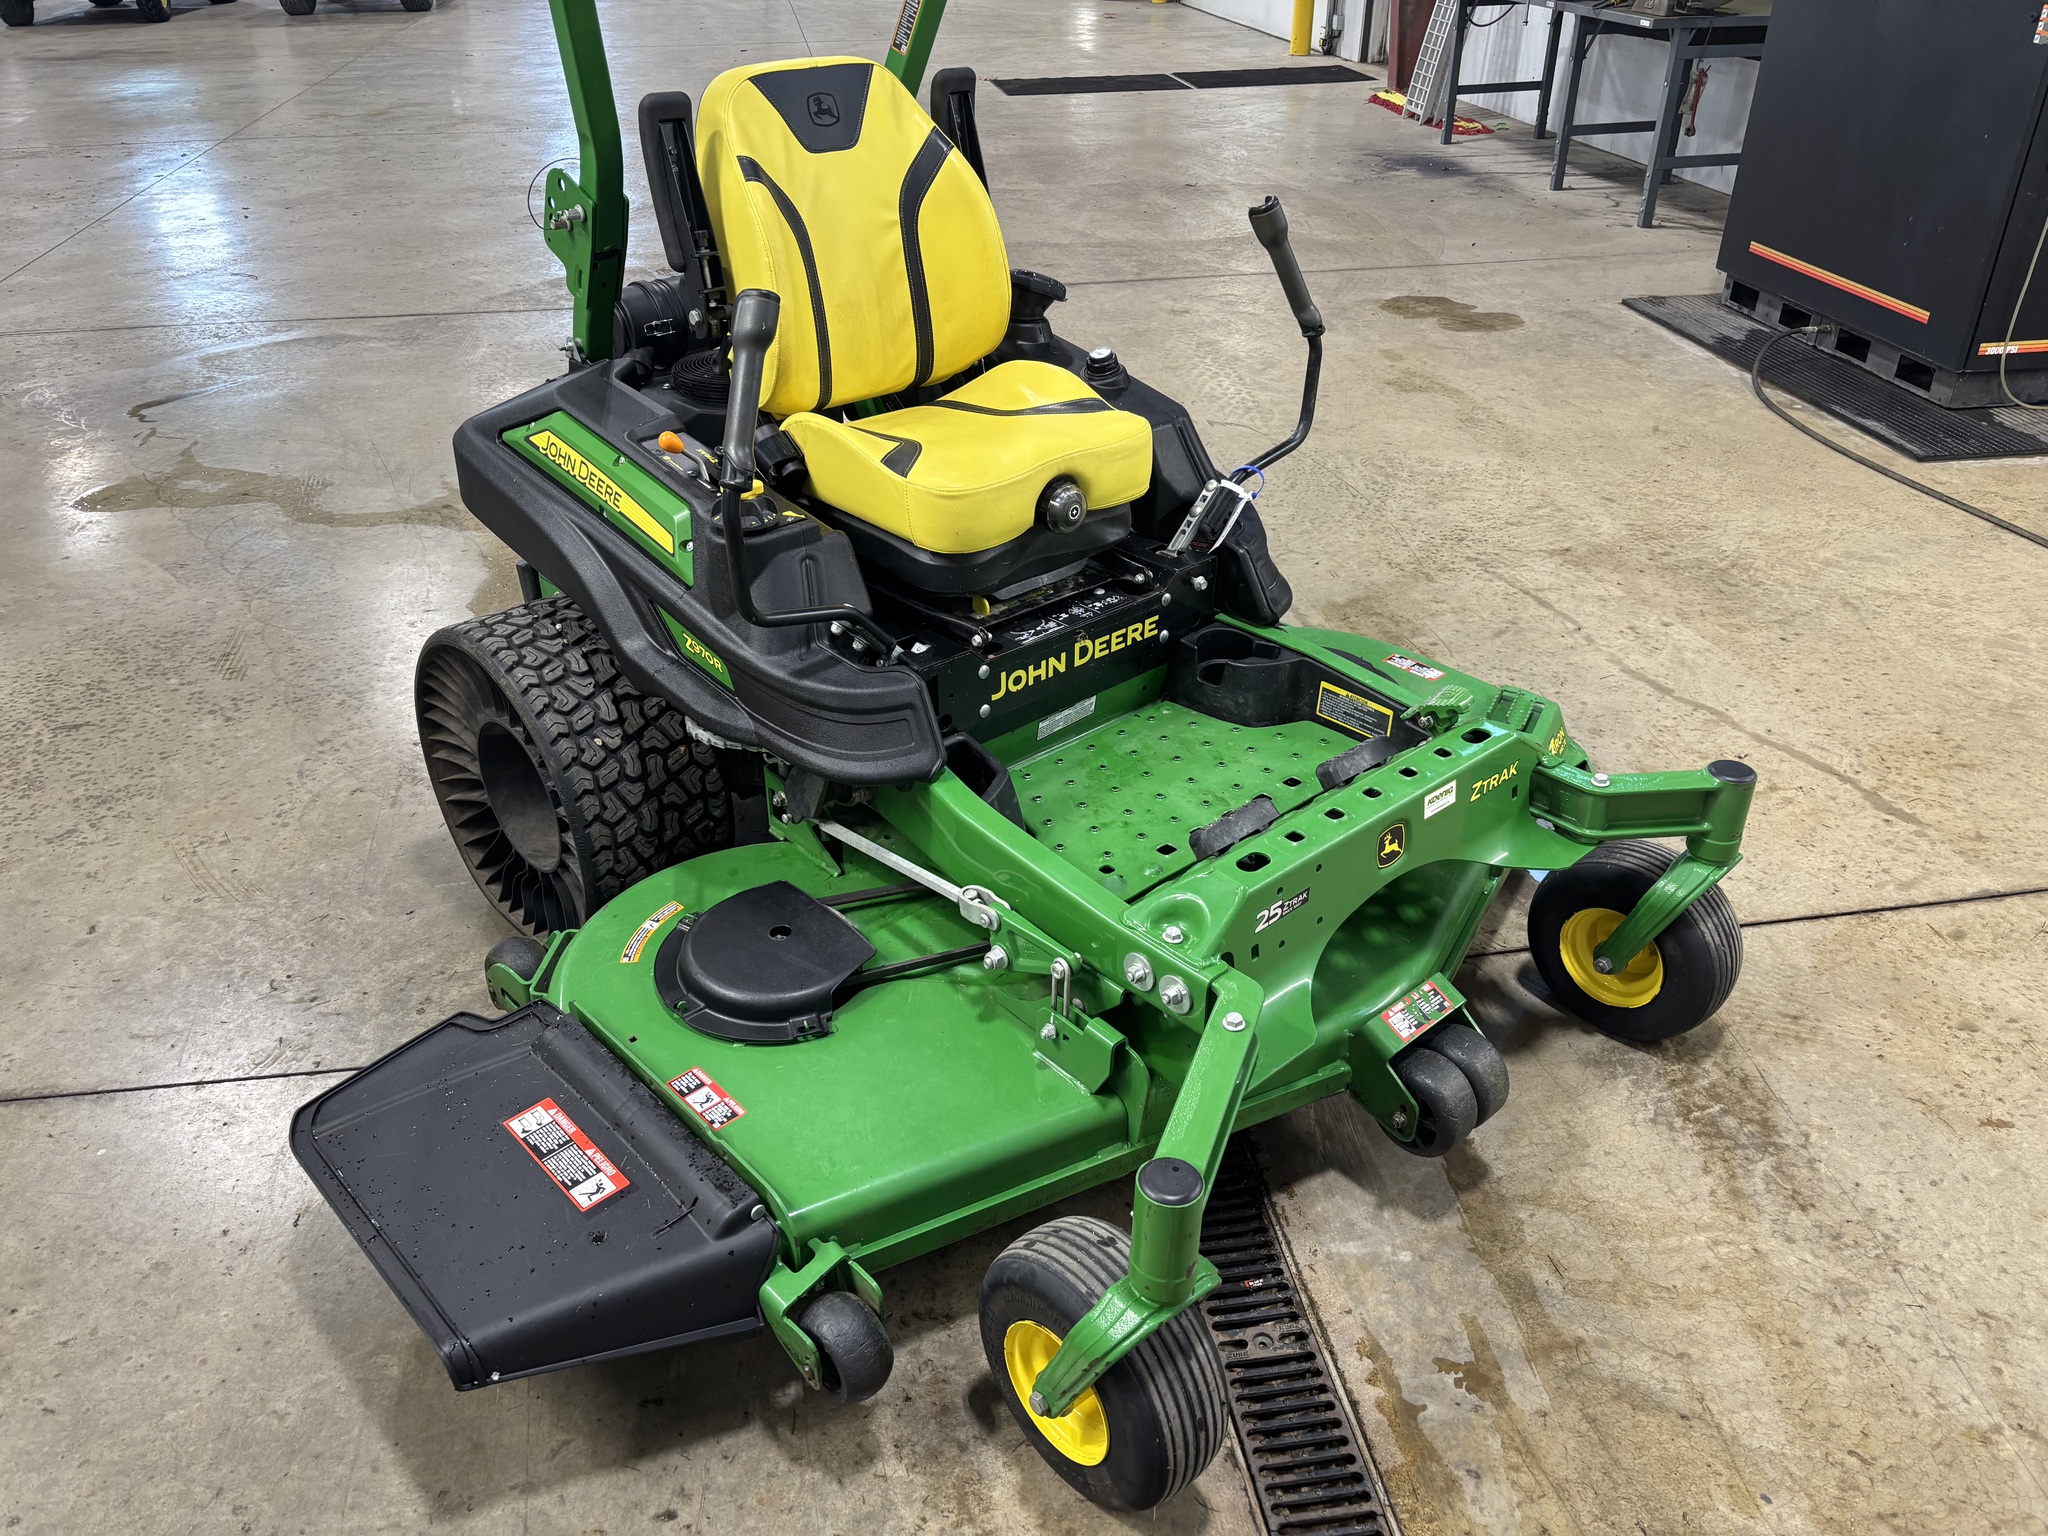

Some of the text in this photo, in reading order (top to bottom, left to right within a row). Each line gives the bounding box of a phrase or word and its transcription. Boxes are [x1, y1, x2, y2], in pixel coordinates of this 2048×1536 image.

[541, 435, 623, 509] JOHN DEERE
[682, 632, 723, 673] Z970R
[991, 652, 1066, 701] JOHN
[1074, 615, 1159, 667] DEERE
[1470, 760, 1519, 803] ZTRAK
[1254, 890, 1308, 934] 25 ZTRAK
[553, 1111, 577, 1134] DANGER
[590, 1151, 617, 1176] PELIGRO
